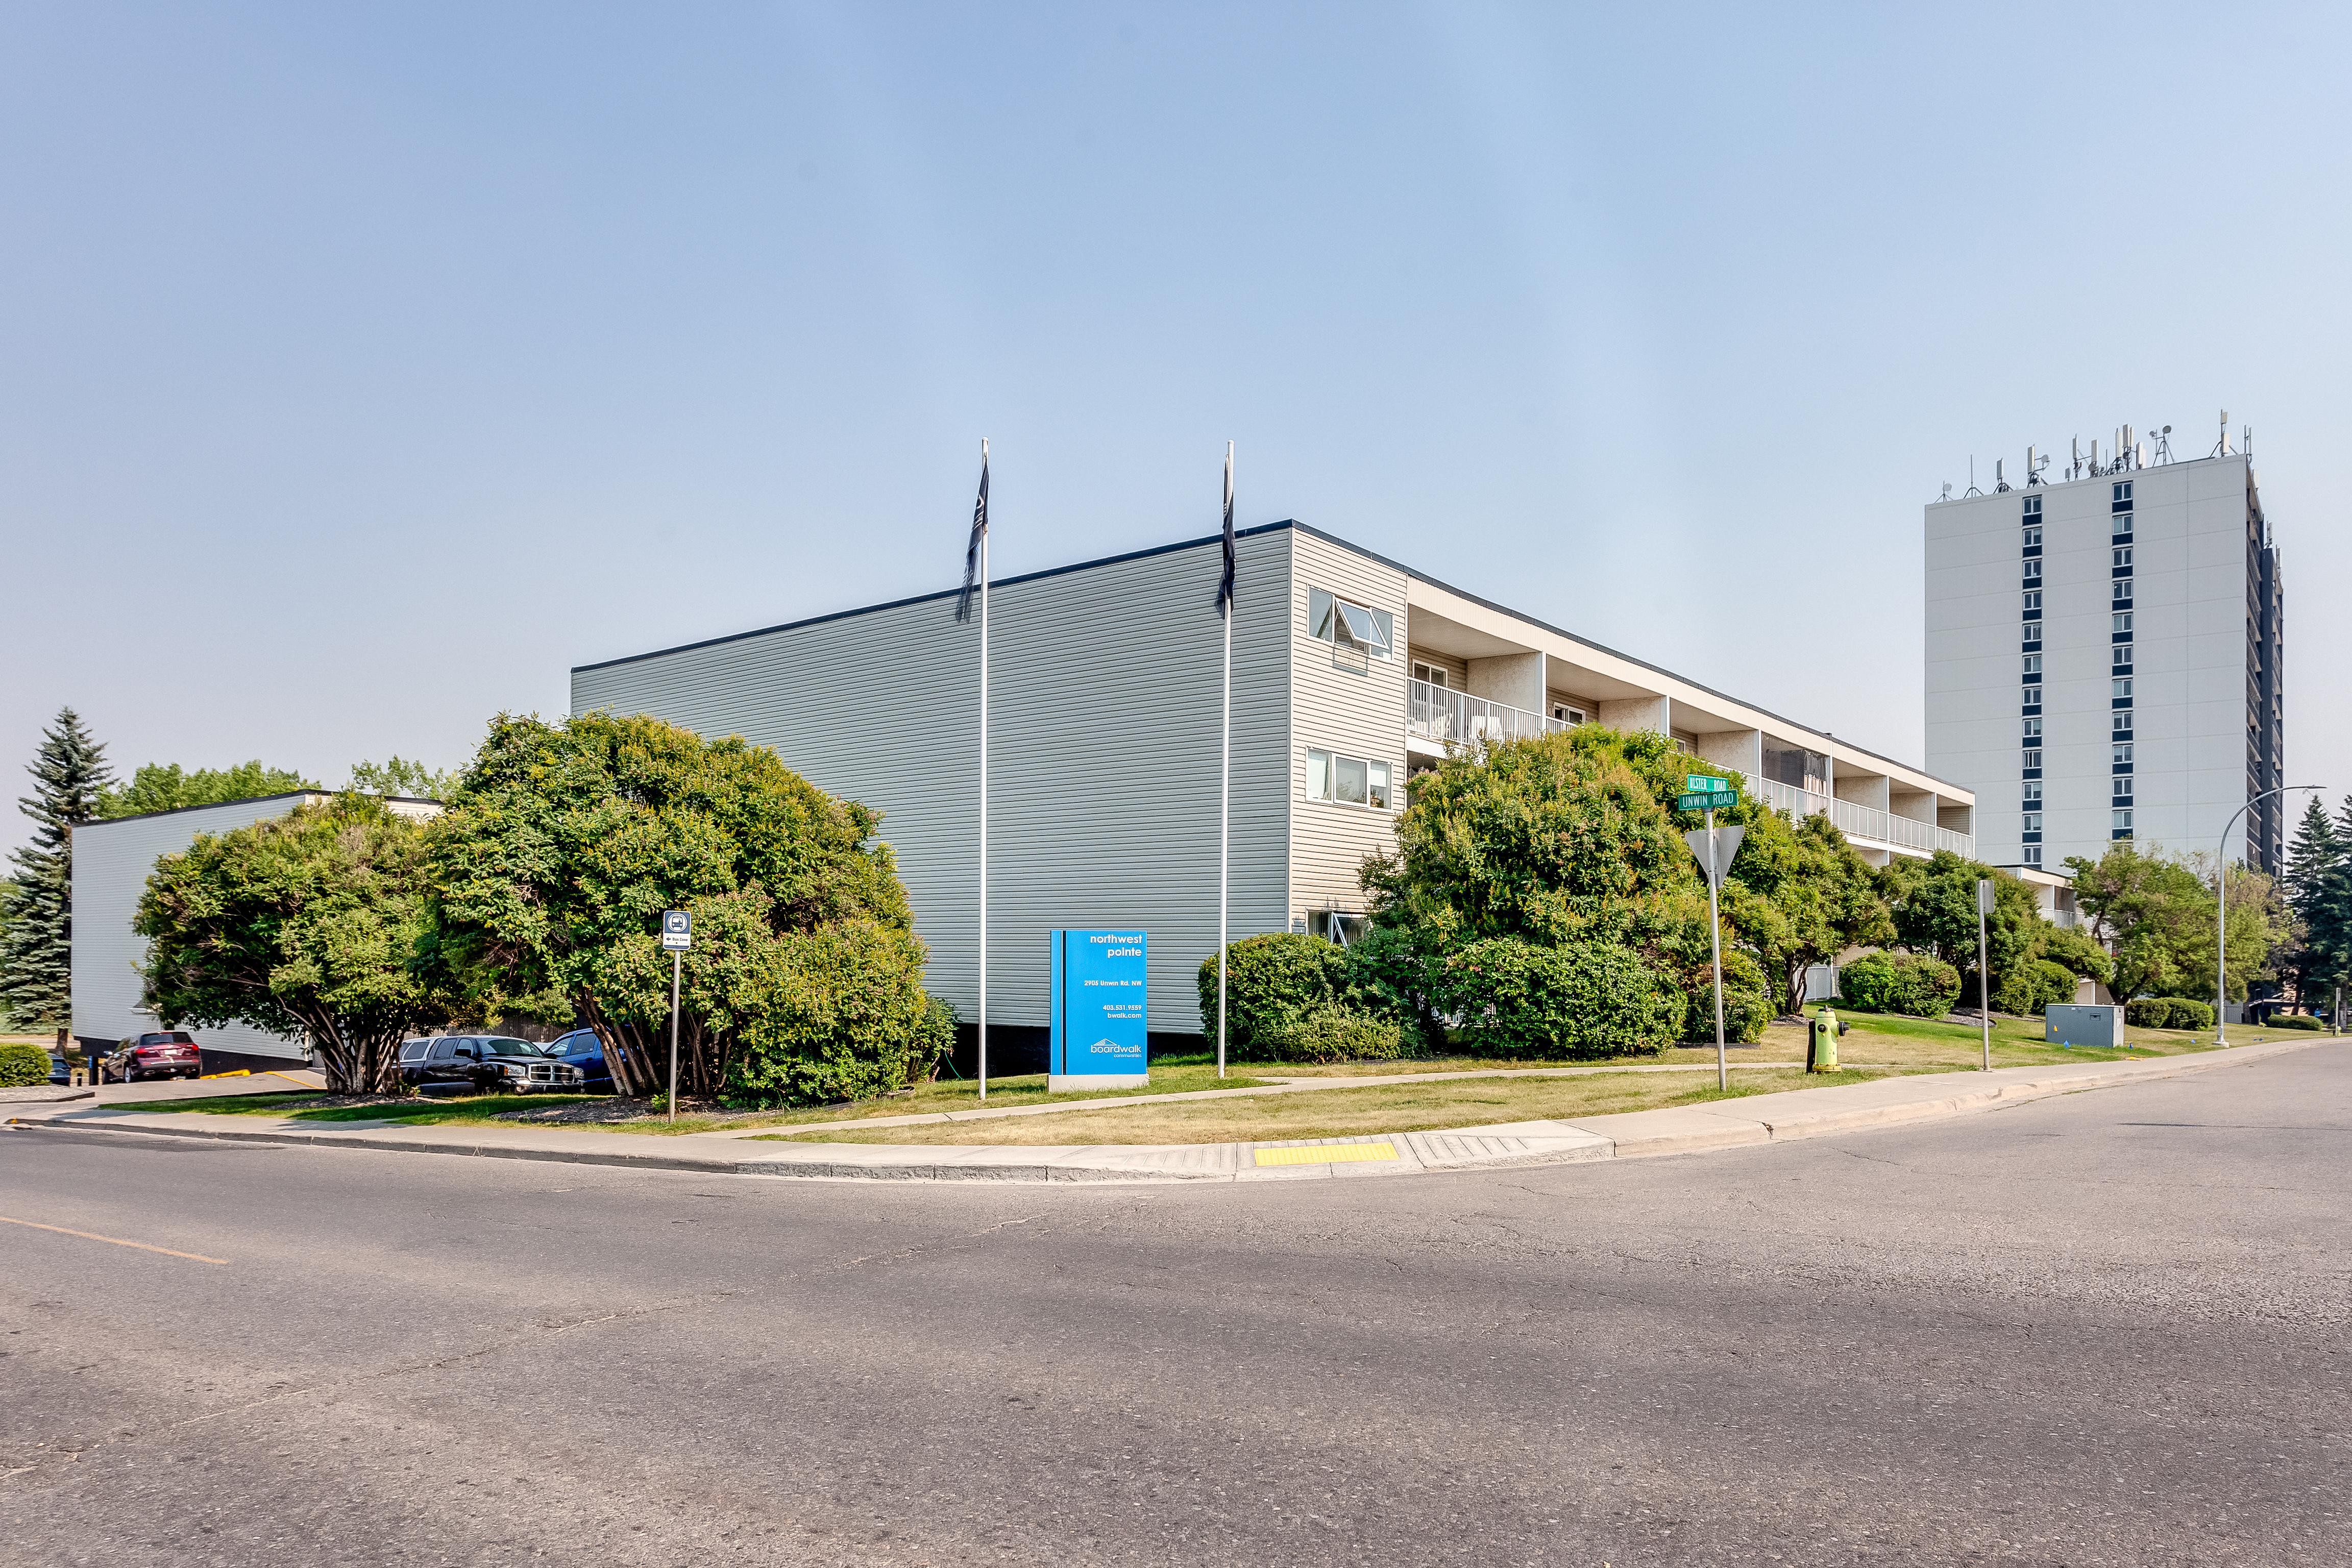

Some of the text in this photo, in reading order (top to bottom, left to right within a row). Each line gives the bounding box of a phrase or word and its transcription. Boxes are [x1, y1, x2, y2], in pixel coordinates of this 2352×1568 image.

[1690, 777, 1726, 791] ULSTER ROAD
[1683, 793, 1733, 807] UNWIN ROAD
[1090, 934, 1142, 944] northwest
[1107, 947, 1142, 958] pointe
[1090, 1044, 1141, 1053] boardwalk
